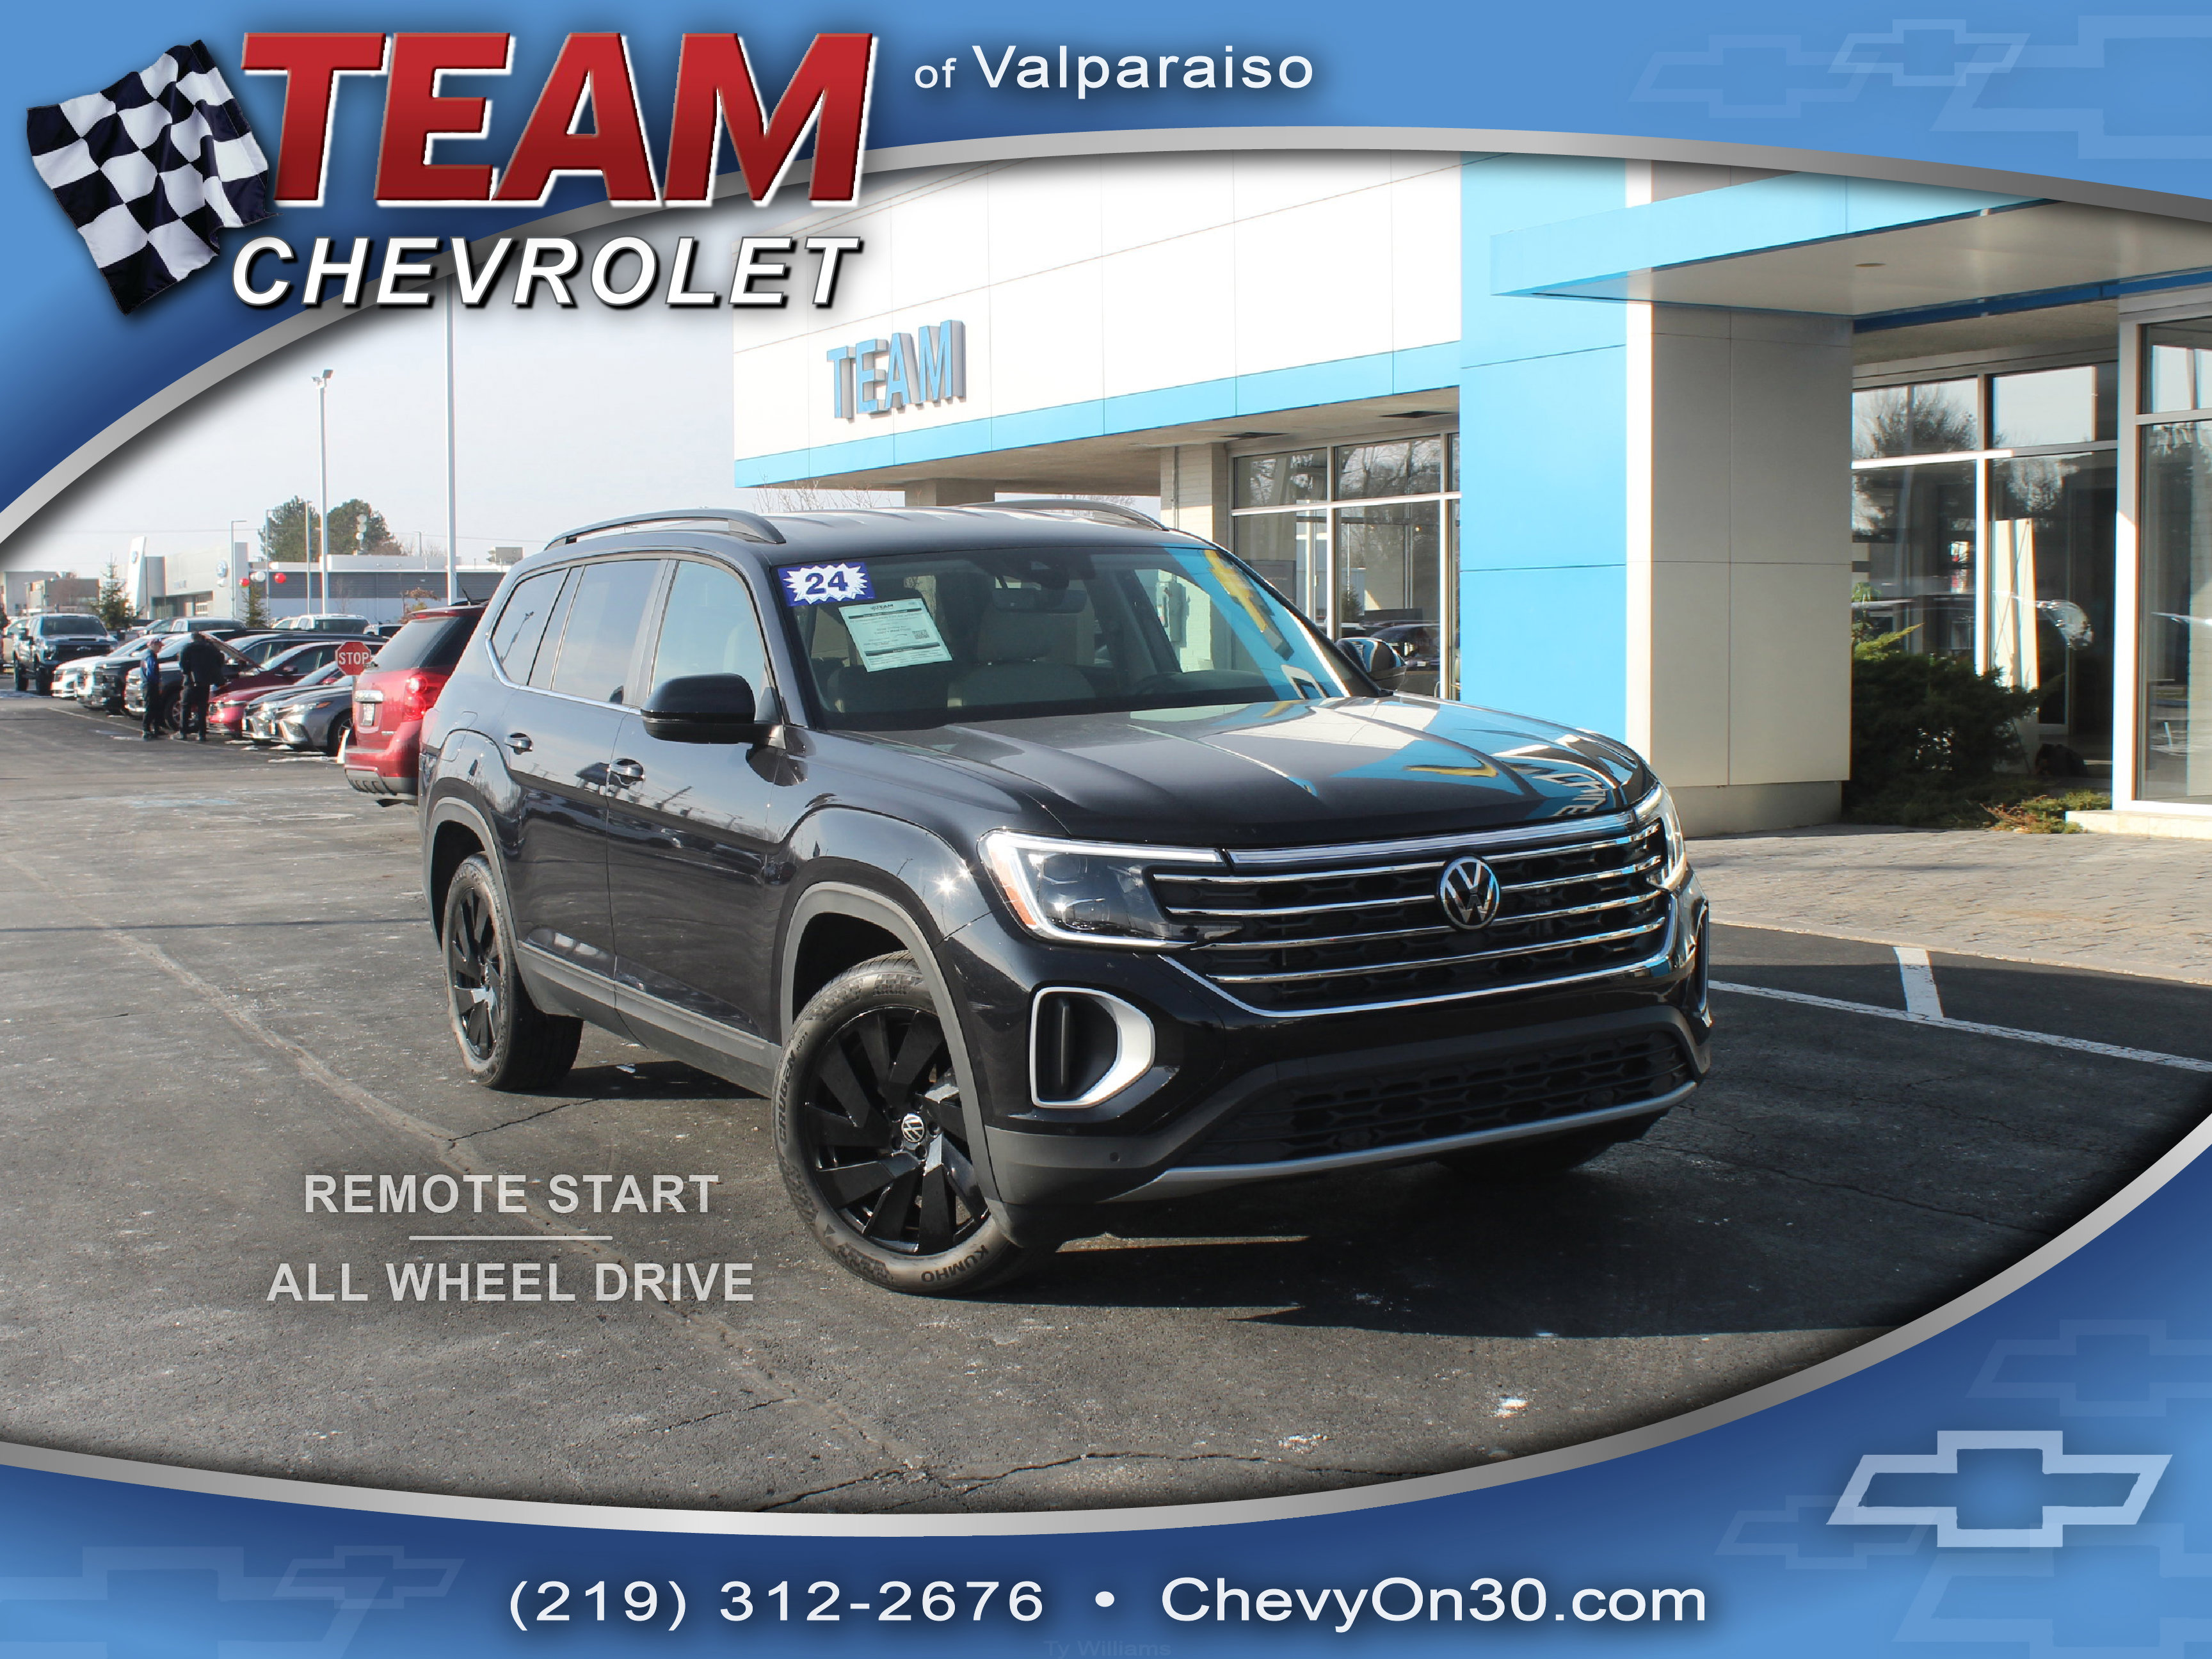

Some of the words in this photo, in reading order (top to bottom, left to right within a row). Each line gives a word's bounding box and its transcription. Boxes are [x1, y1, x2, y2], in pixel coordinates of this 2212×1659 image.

[826, 319, 967, 424] TEAM
[805, 570, 849, 595] 24
[338, 652, 369, 665] STOP
[778, 1050, 796, 1145] CRUGEN
[920, 1244, 990, 1283] KUMHO
